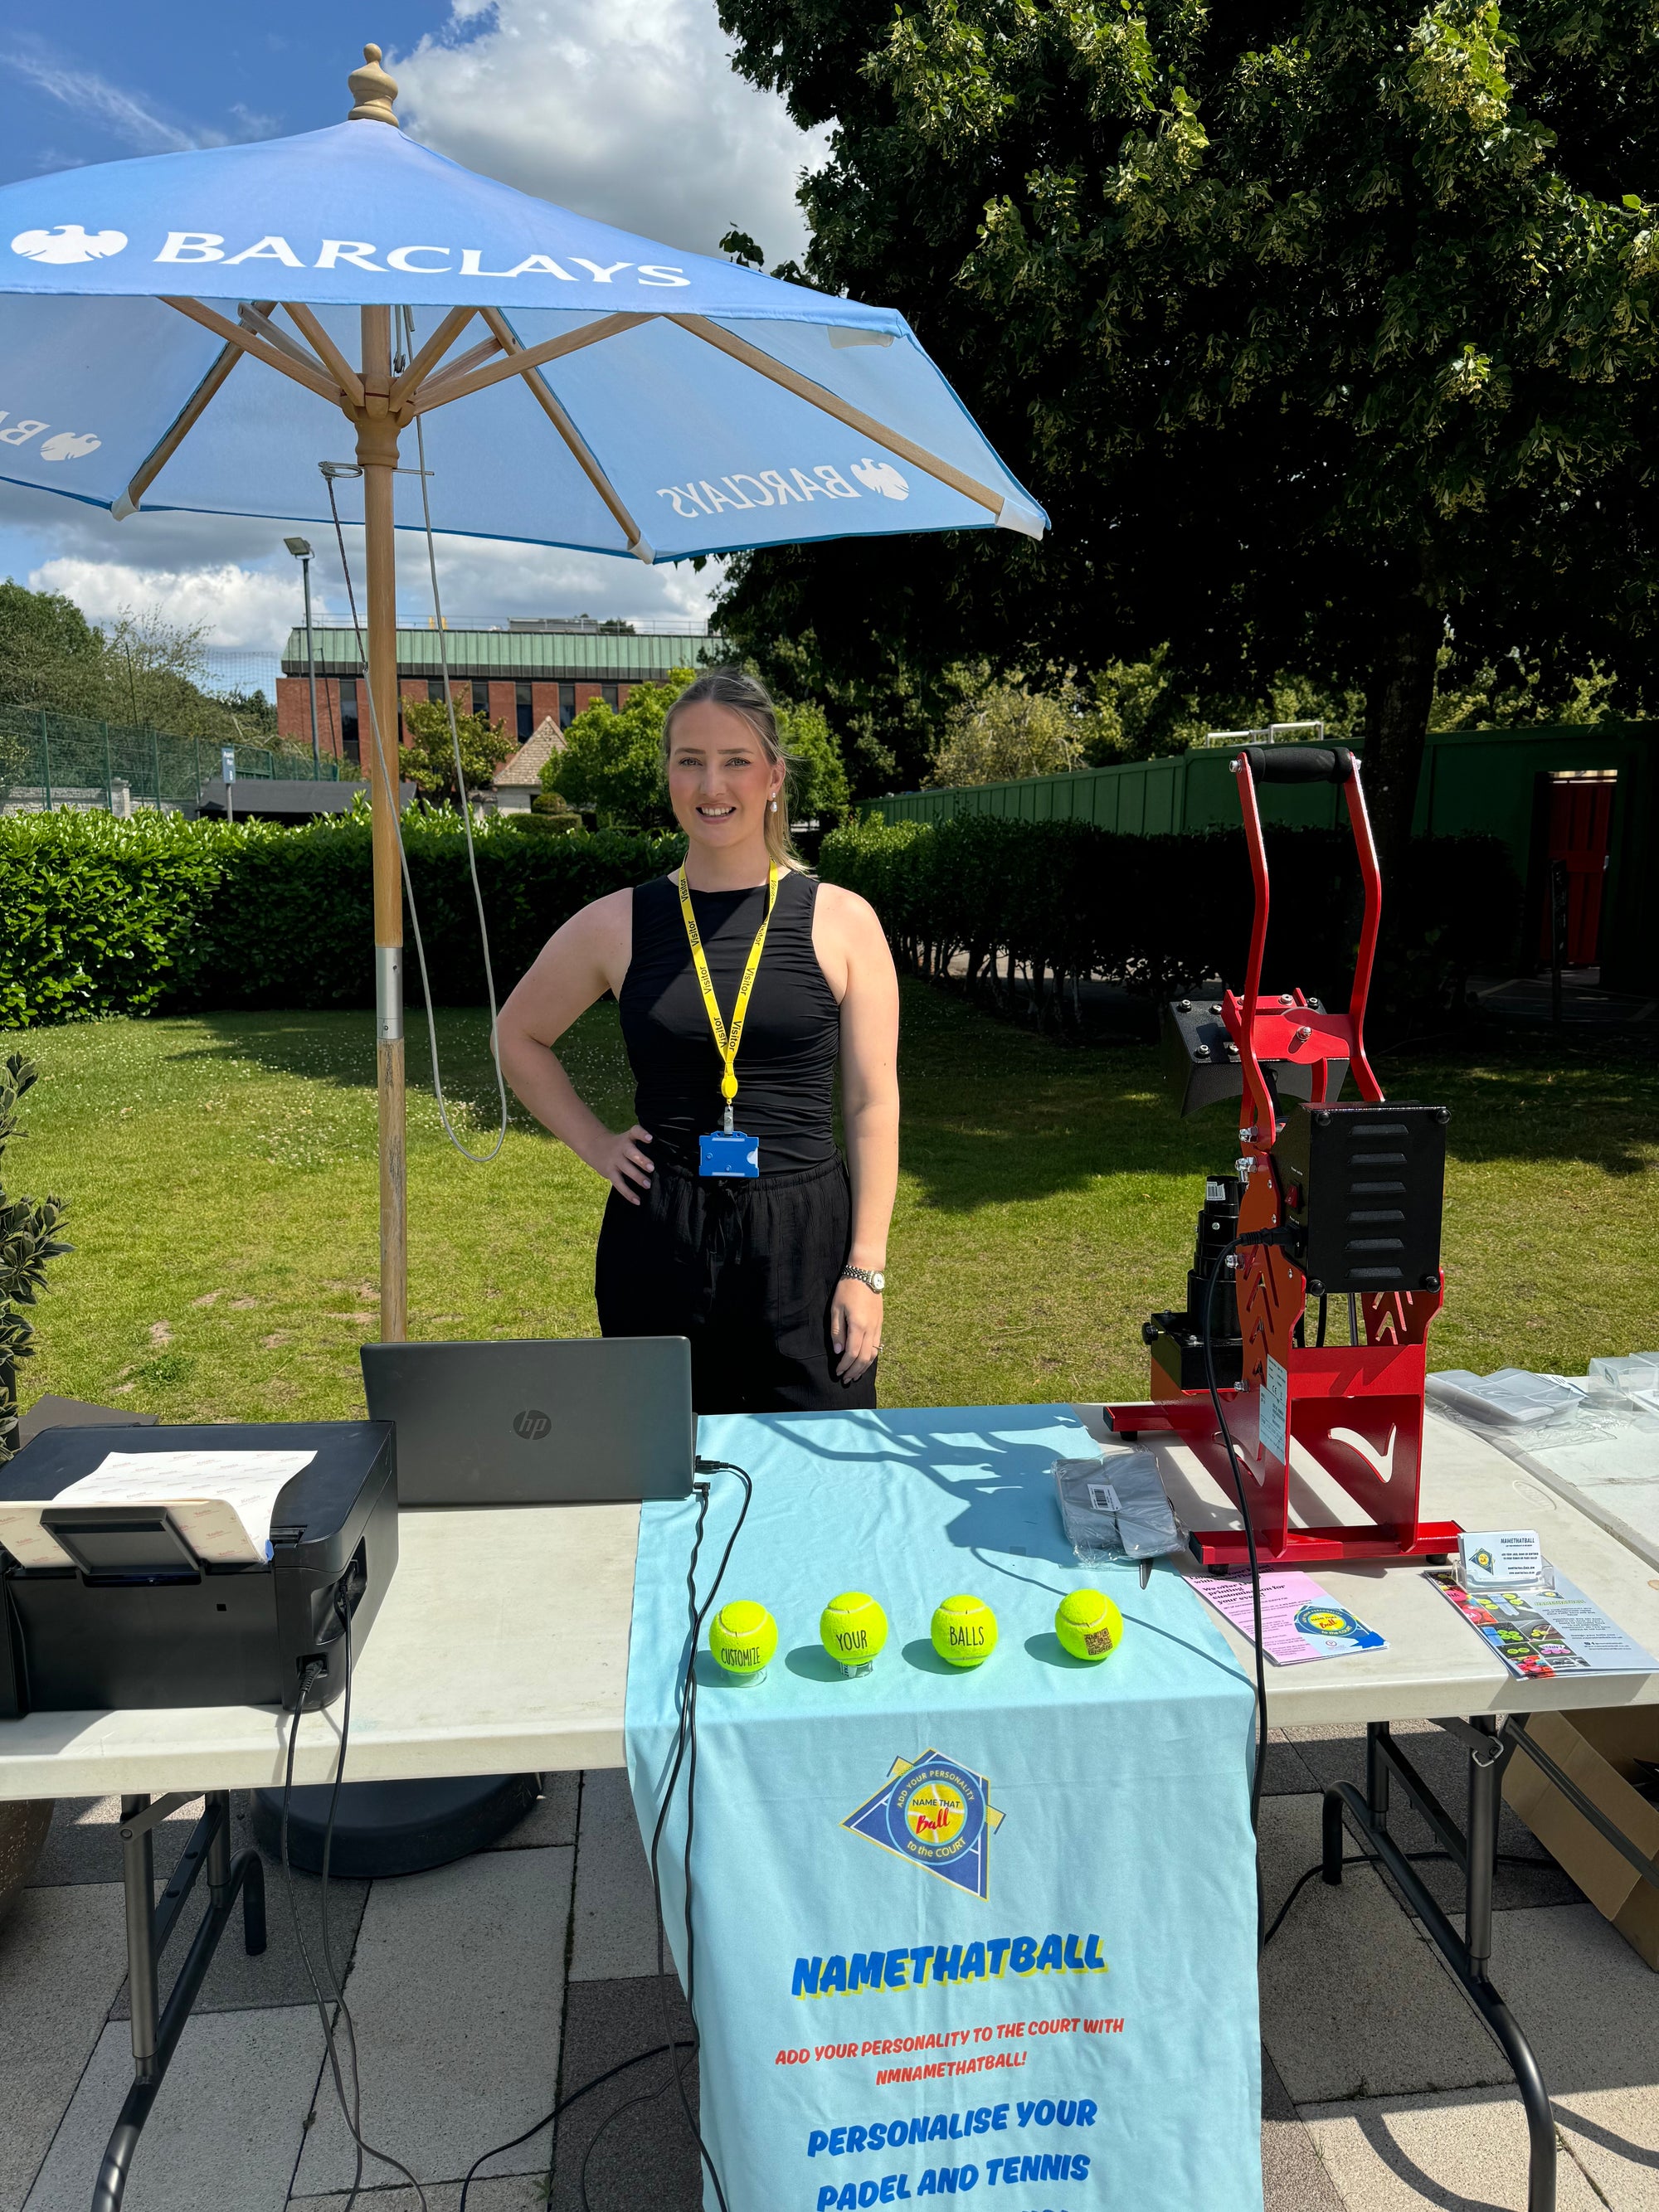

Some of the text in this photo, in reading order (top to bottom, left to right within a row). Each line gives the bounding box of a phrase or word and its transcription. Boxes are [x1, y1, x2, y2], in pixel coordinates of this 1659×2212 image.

[154, 231, 691, 287] BARCLAYS
[680, 878, 689, 902] Visitor
[688, 921, 699, 946] Visitor
[699, 966, 712, 994] Visitor
[741, 967, 755, 995] Visitor
[713, 1017, 727, 1048] Visitor
[729, 1021, 742, 1052] Visitor
[518, 1407, 547, 1441] hp
[1208, 1587, 1244, 1596] printing
[836, 1630, 868, 1651] YOUR
[950, 1626, 985, 1646] BALLS
[721, 1646, 761, 1666] CUSTOMIZE
[897, 1770, 975, 1808] ADD YOUR PERSONALITY
[939, 1799, 961, 1808] THAT
[916, 1807, 951, 1835] Ball
[907, 1836, 966, 1858] to the COURT
[792, 1934, 1107, 2000] NAMETHATBALL
[776, 2018, 1125, 2065] ADD YOUR PERSONALITY TO THE COURT WITH
[876, 2051, 1027, 2085] NMNAMETHATBALL!
[808, 2099, 1097, 2157] PERSONALISE YOUR
[817, 2154, 1091, 2212] PADEL AND TENNIS
